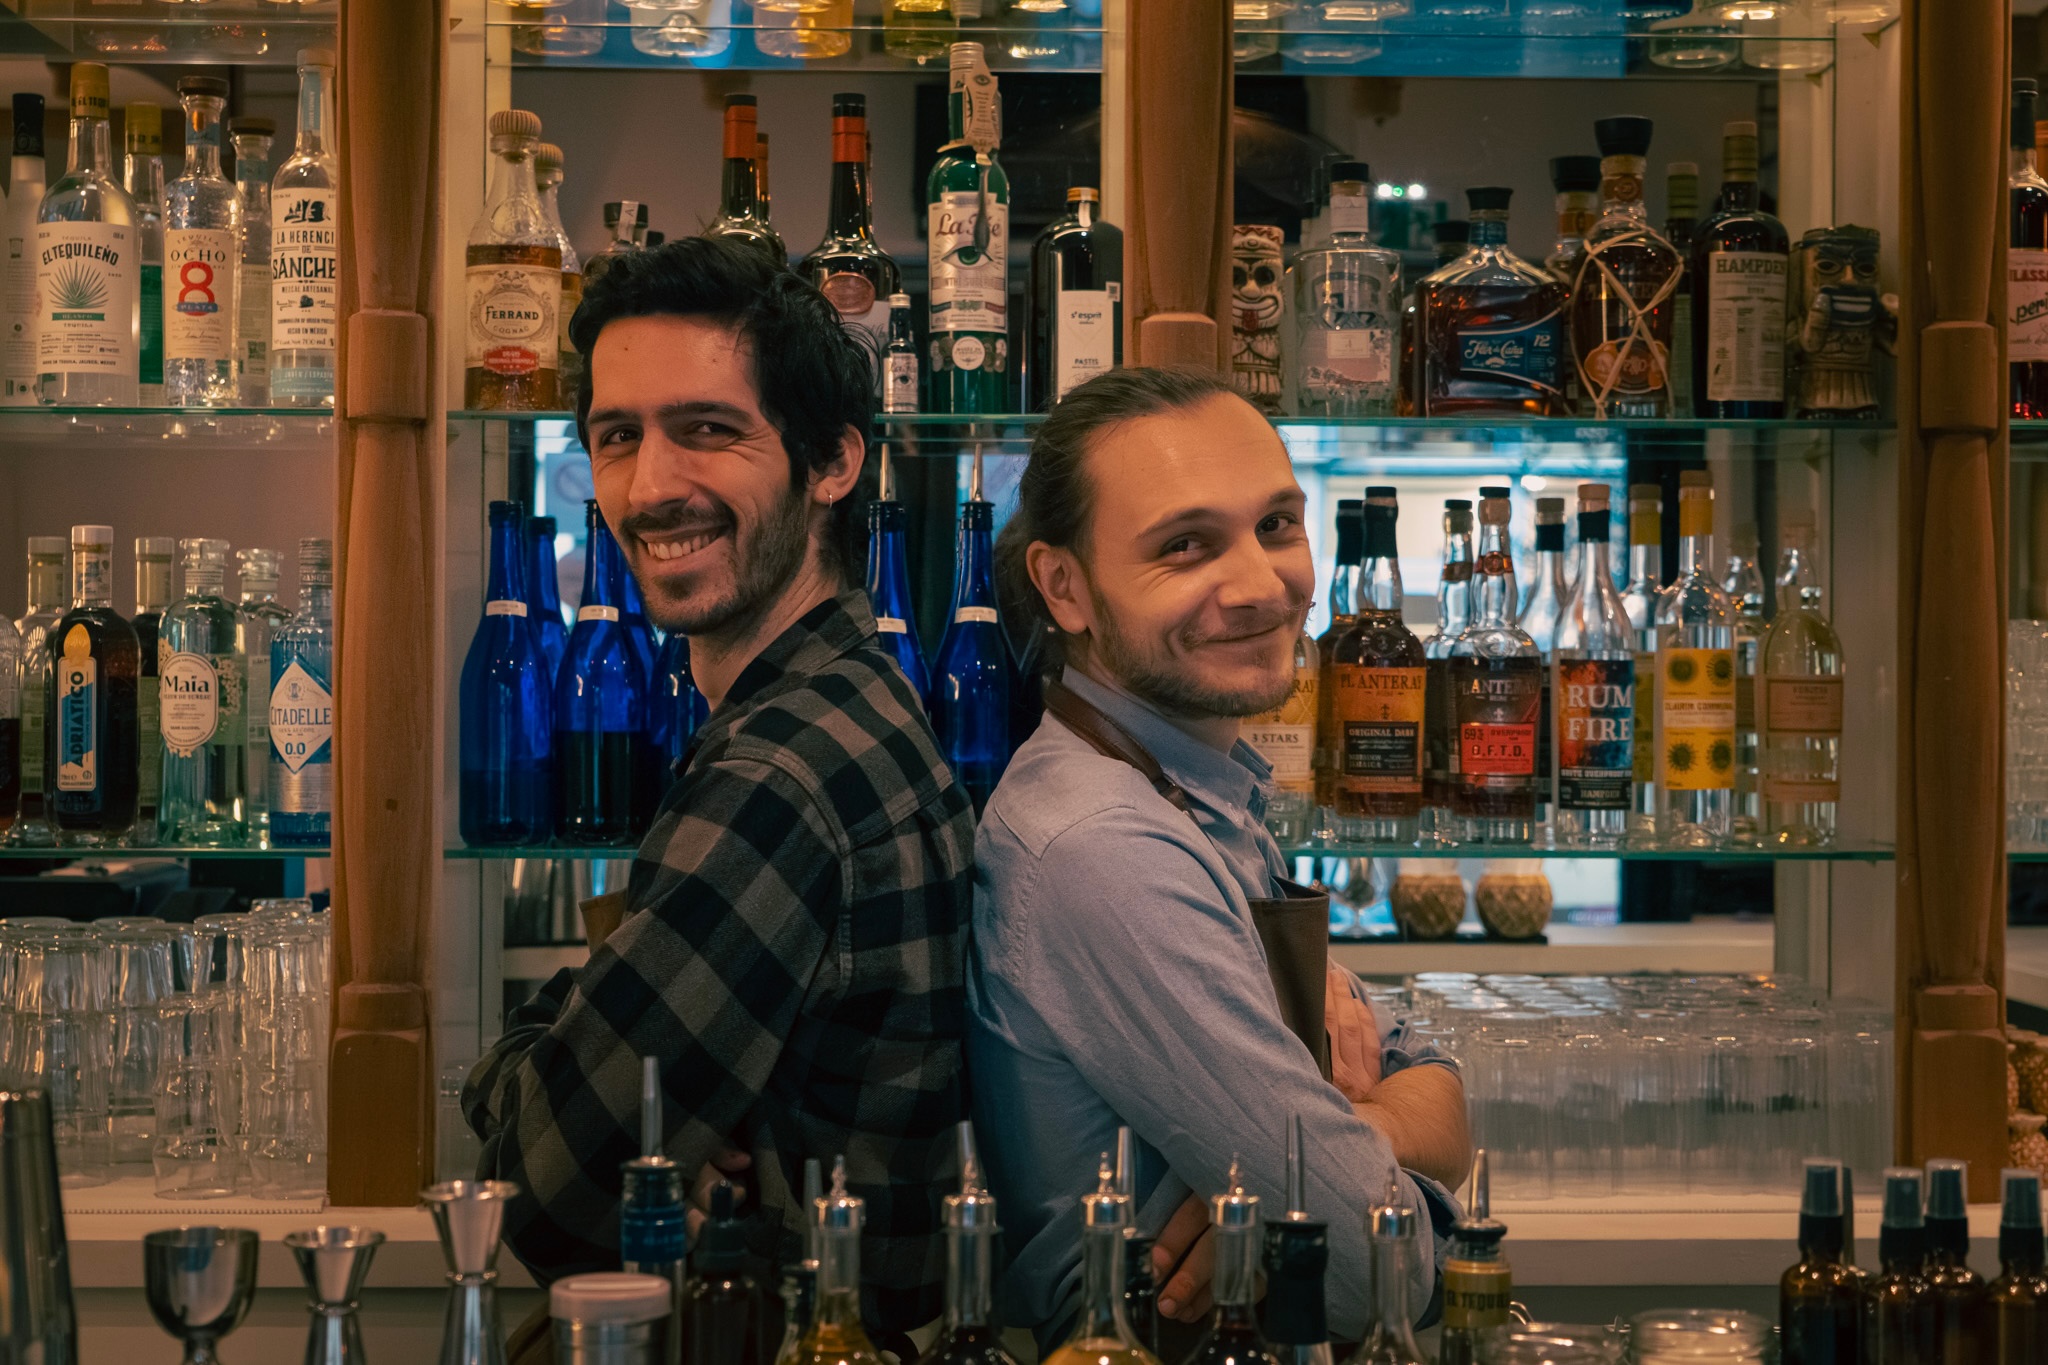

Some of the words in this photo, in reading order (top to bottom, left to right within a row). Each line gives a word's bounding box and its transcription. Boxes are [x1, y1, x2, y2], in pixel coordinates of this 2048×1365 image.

[935, 213, 963, 238] La
[276, 231, 285, 245] LA
[289, 230, 335, 245] HERENCI
[170, 249, 226, 263] OCHO
[301, 245, 311, 253] DE
[272, 253, 336, 280] SÁNCHE
[179, 261, 215, 317] 8
[486, 305, 539, 324] FERRAND
[494, 325, 529, 334] COGNAC
[1533, 334, 1551, 347] 12
[1074, 358, 1099, 366] PASTIS
[164, 675, 210, 693] Maïa
[1567, 684, 1632, 709] RUM
[70, 671, 84, 768] ADRIATICO
[271, 706, 332, 726] CITADELLE
[1348, 728, 1392, 737] ORIGINAL
[1567, 717, 1631, 742] FIRE
[1252, 733, 1258, 743] 3
[1261, 733, 1299, 744] STARS
[285, 742, 306, 755] 0.0
[1471, 744, 1526, 758] O.F.T.D.
